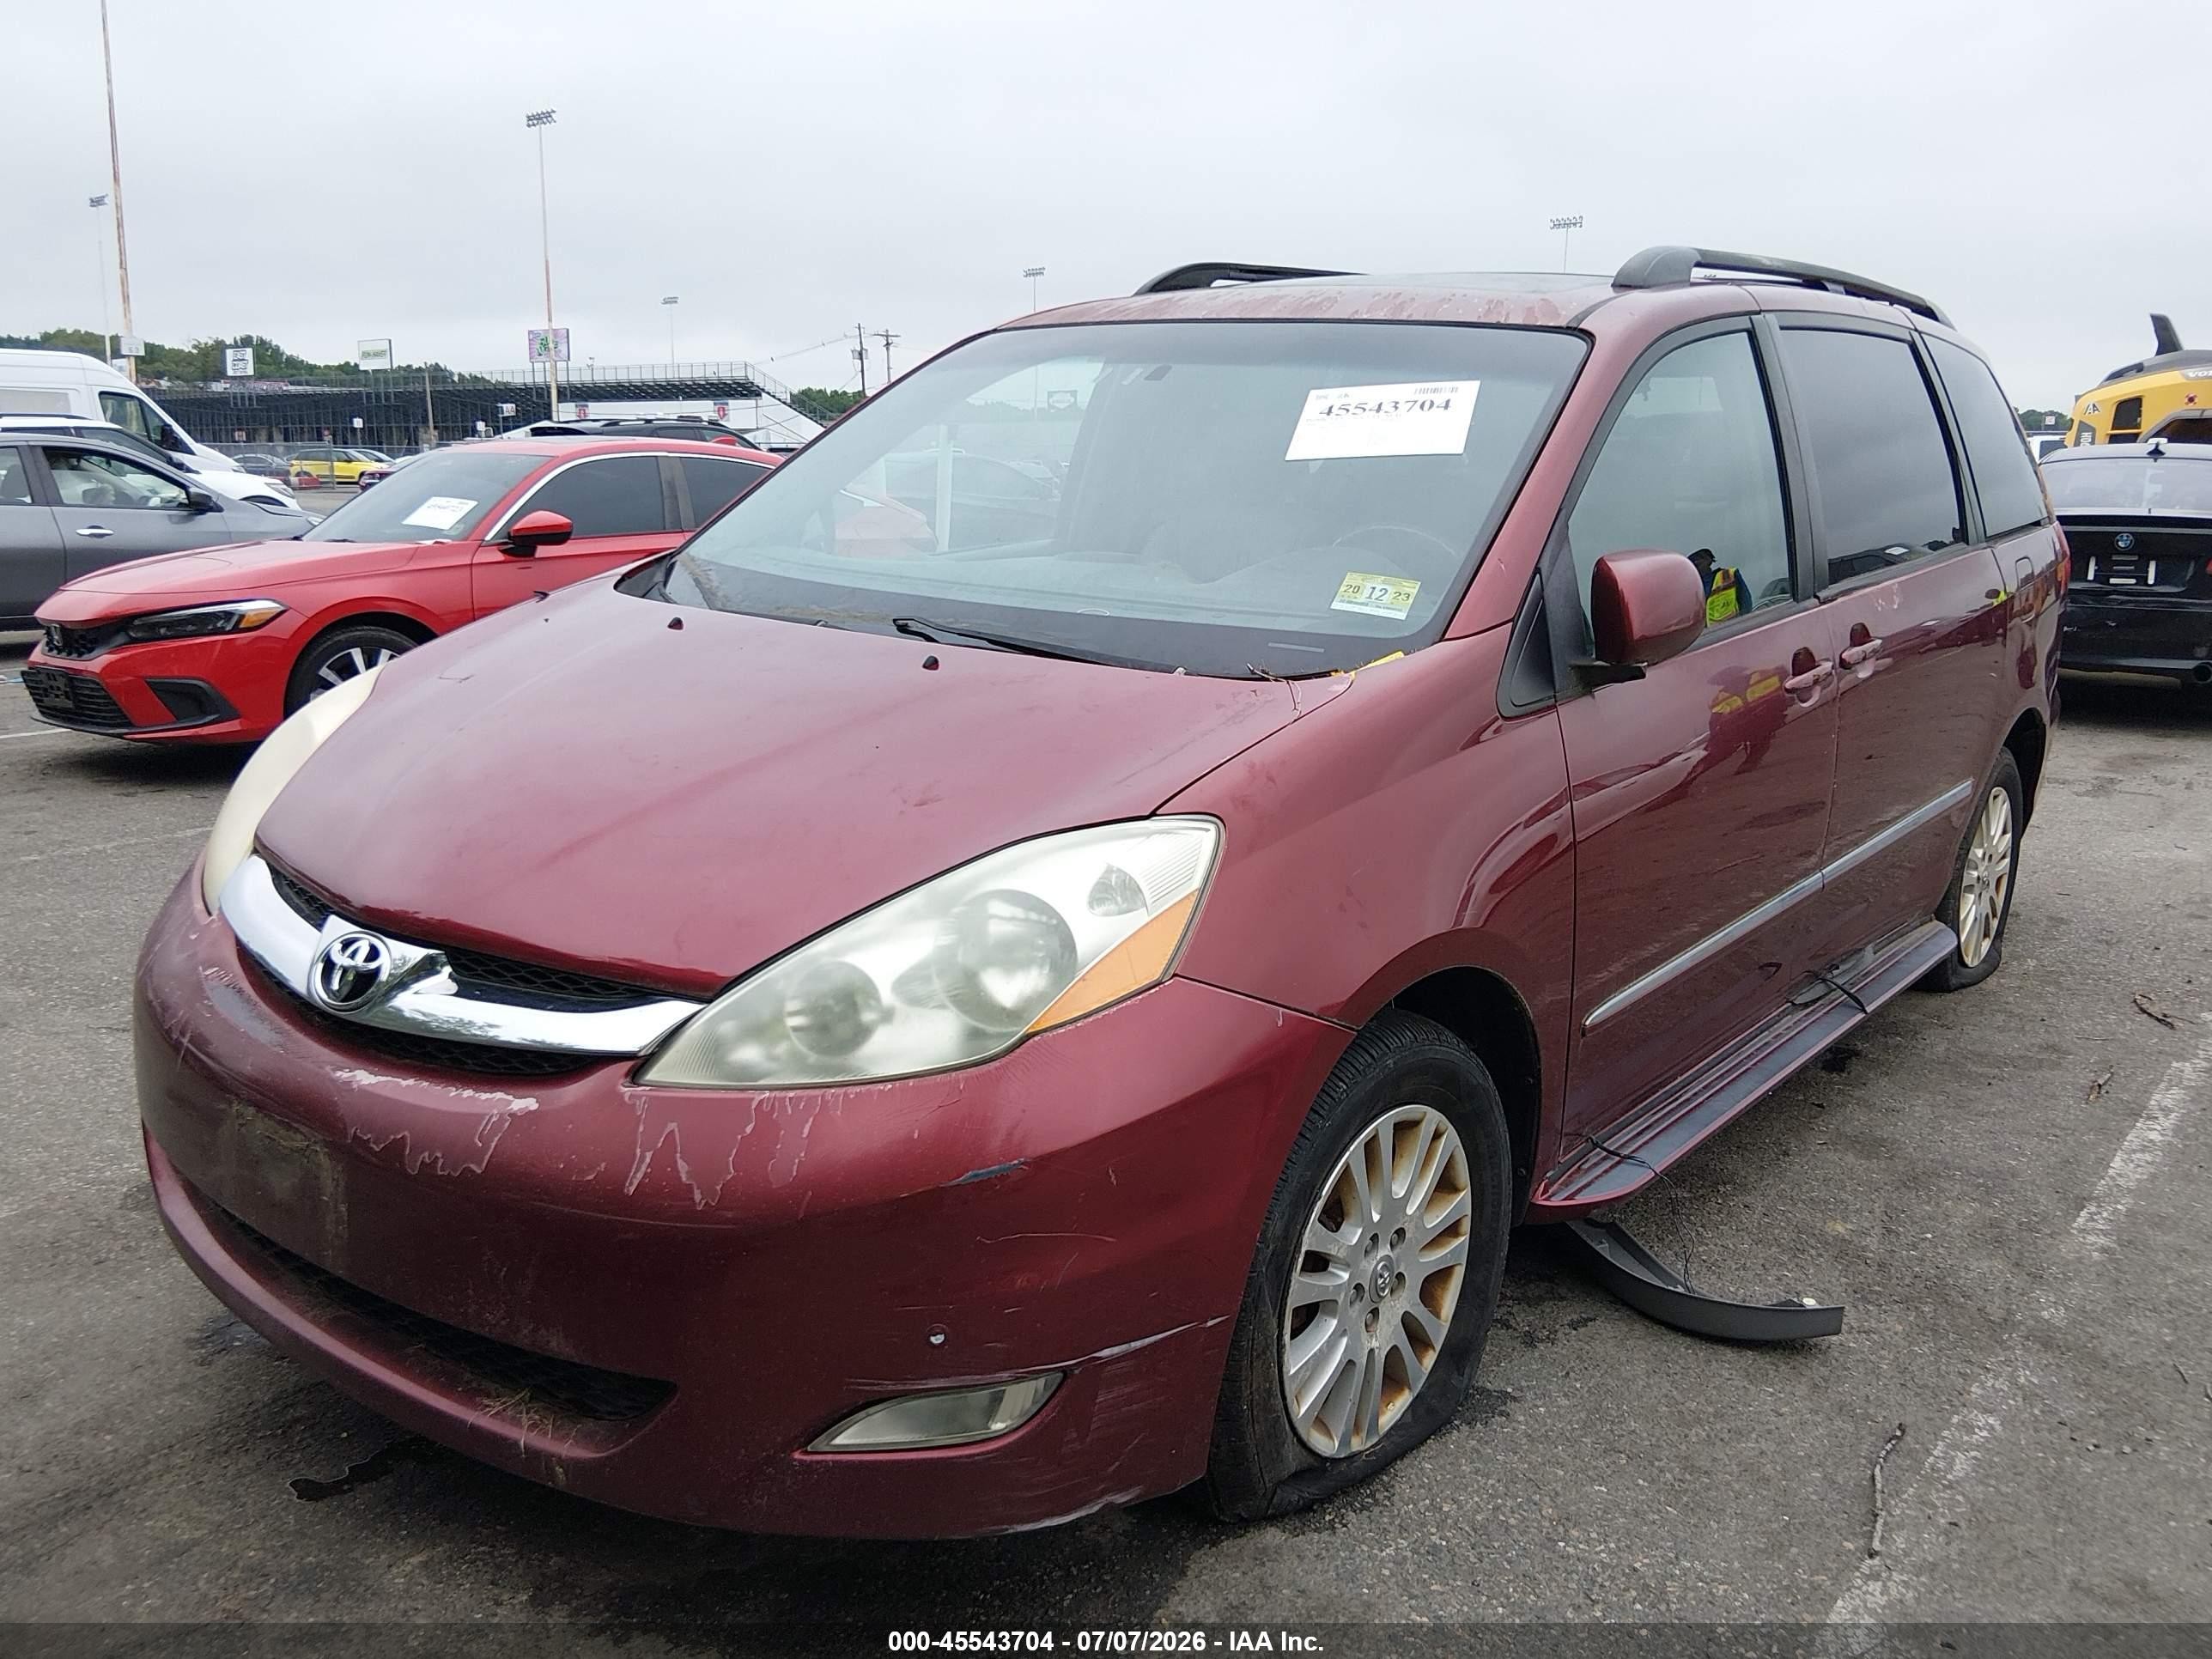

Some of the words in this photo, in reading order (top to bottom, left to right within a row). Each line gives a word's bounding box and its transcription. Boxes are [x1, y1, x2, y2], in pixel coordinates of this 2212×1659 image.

[1318, 398, 1452, 416] 45543704
[1343, 584, 1361, 594] 20
[1365, 586, 1389, 602] 12
[1392, 591, 1411, 602] 23
